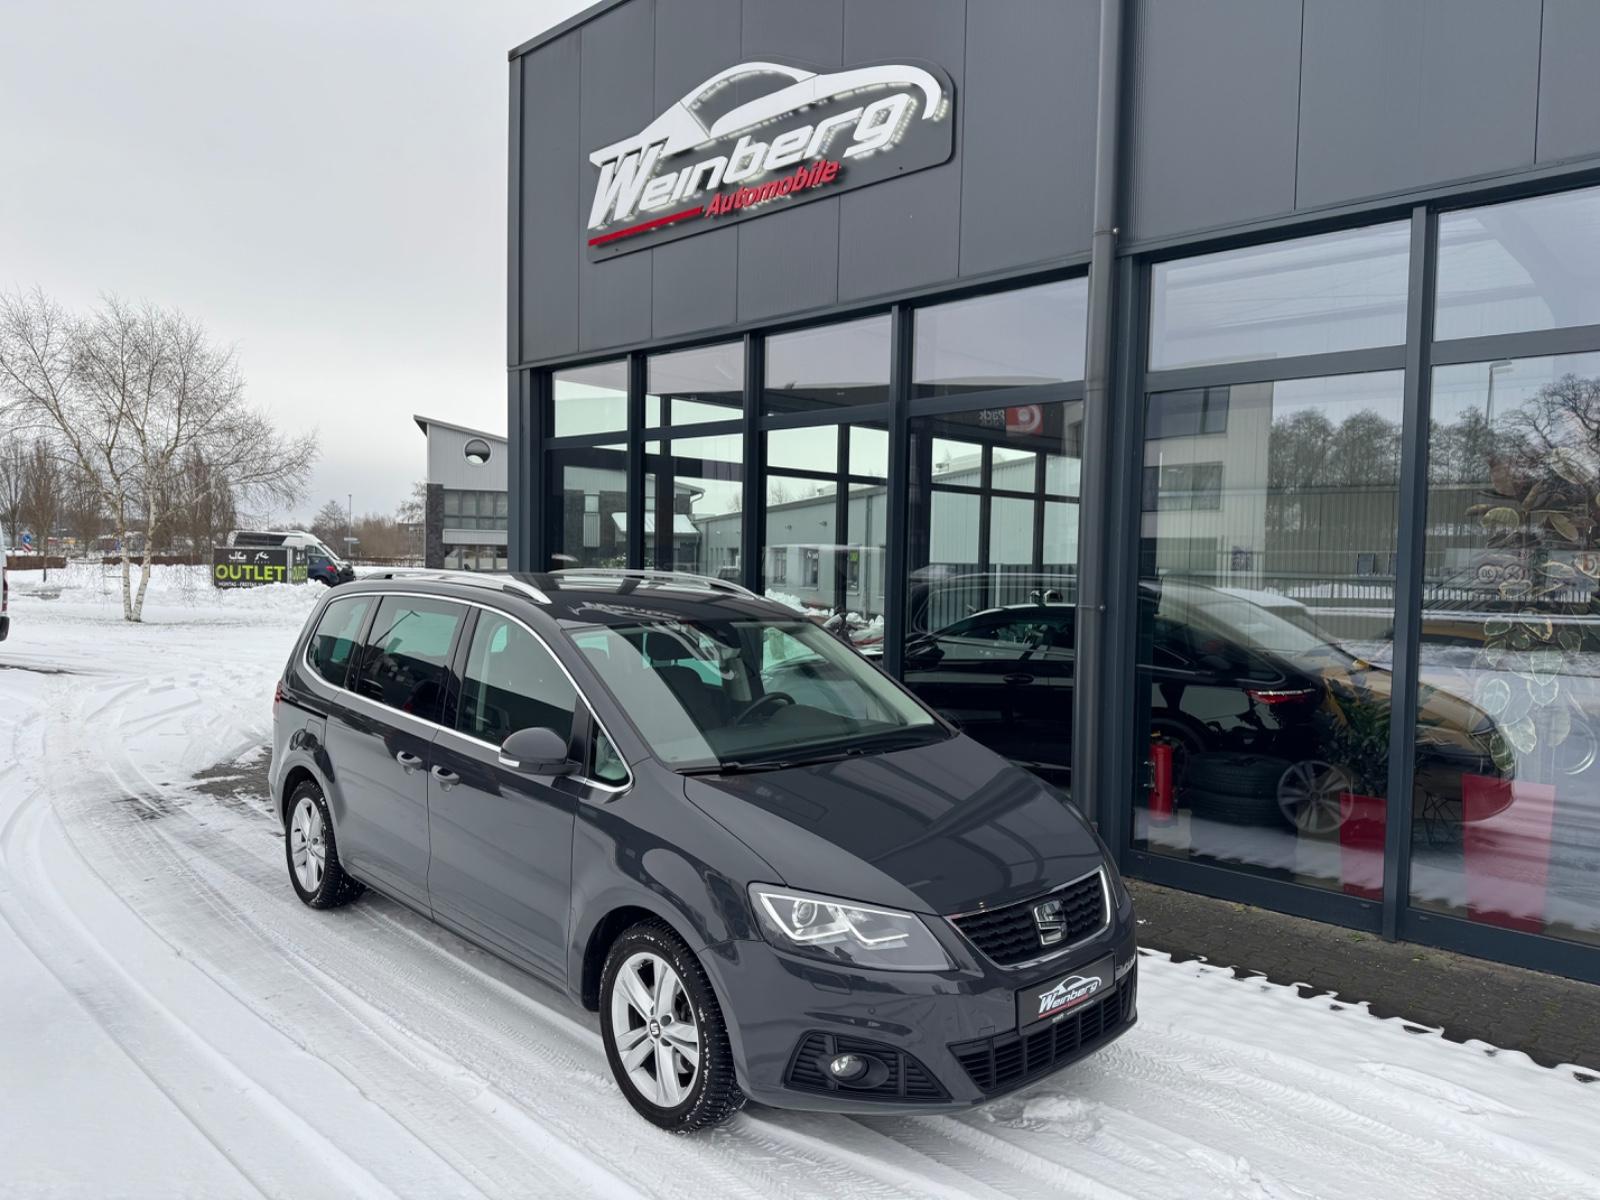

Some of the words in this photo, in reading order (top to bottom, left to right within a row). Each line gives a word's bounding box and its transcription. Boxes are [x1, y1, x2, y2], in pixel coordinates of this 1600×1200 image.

[588, 93, 913, 230] Weinberg
[704, 158, 841, 218] Automobile
[215, 564, 286, 581] OUTLET
[1038, 981, 1098, 1014] Weinberg
